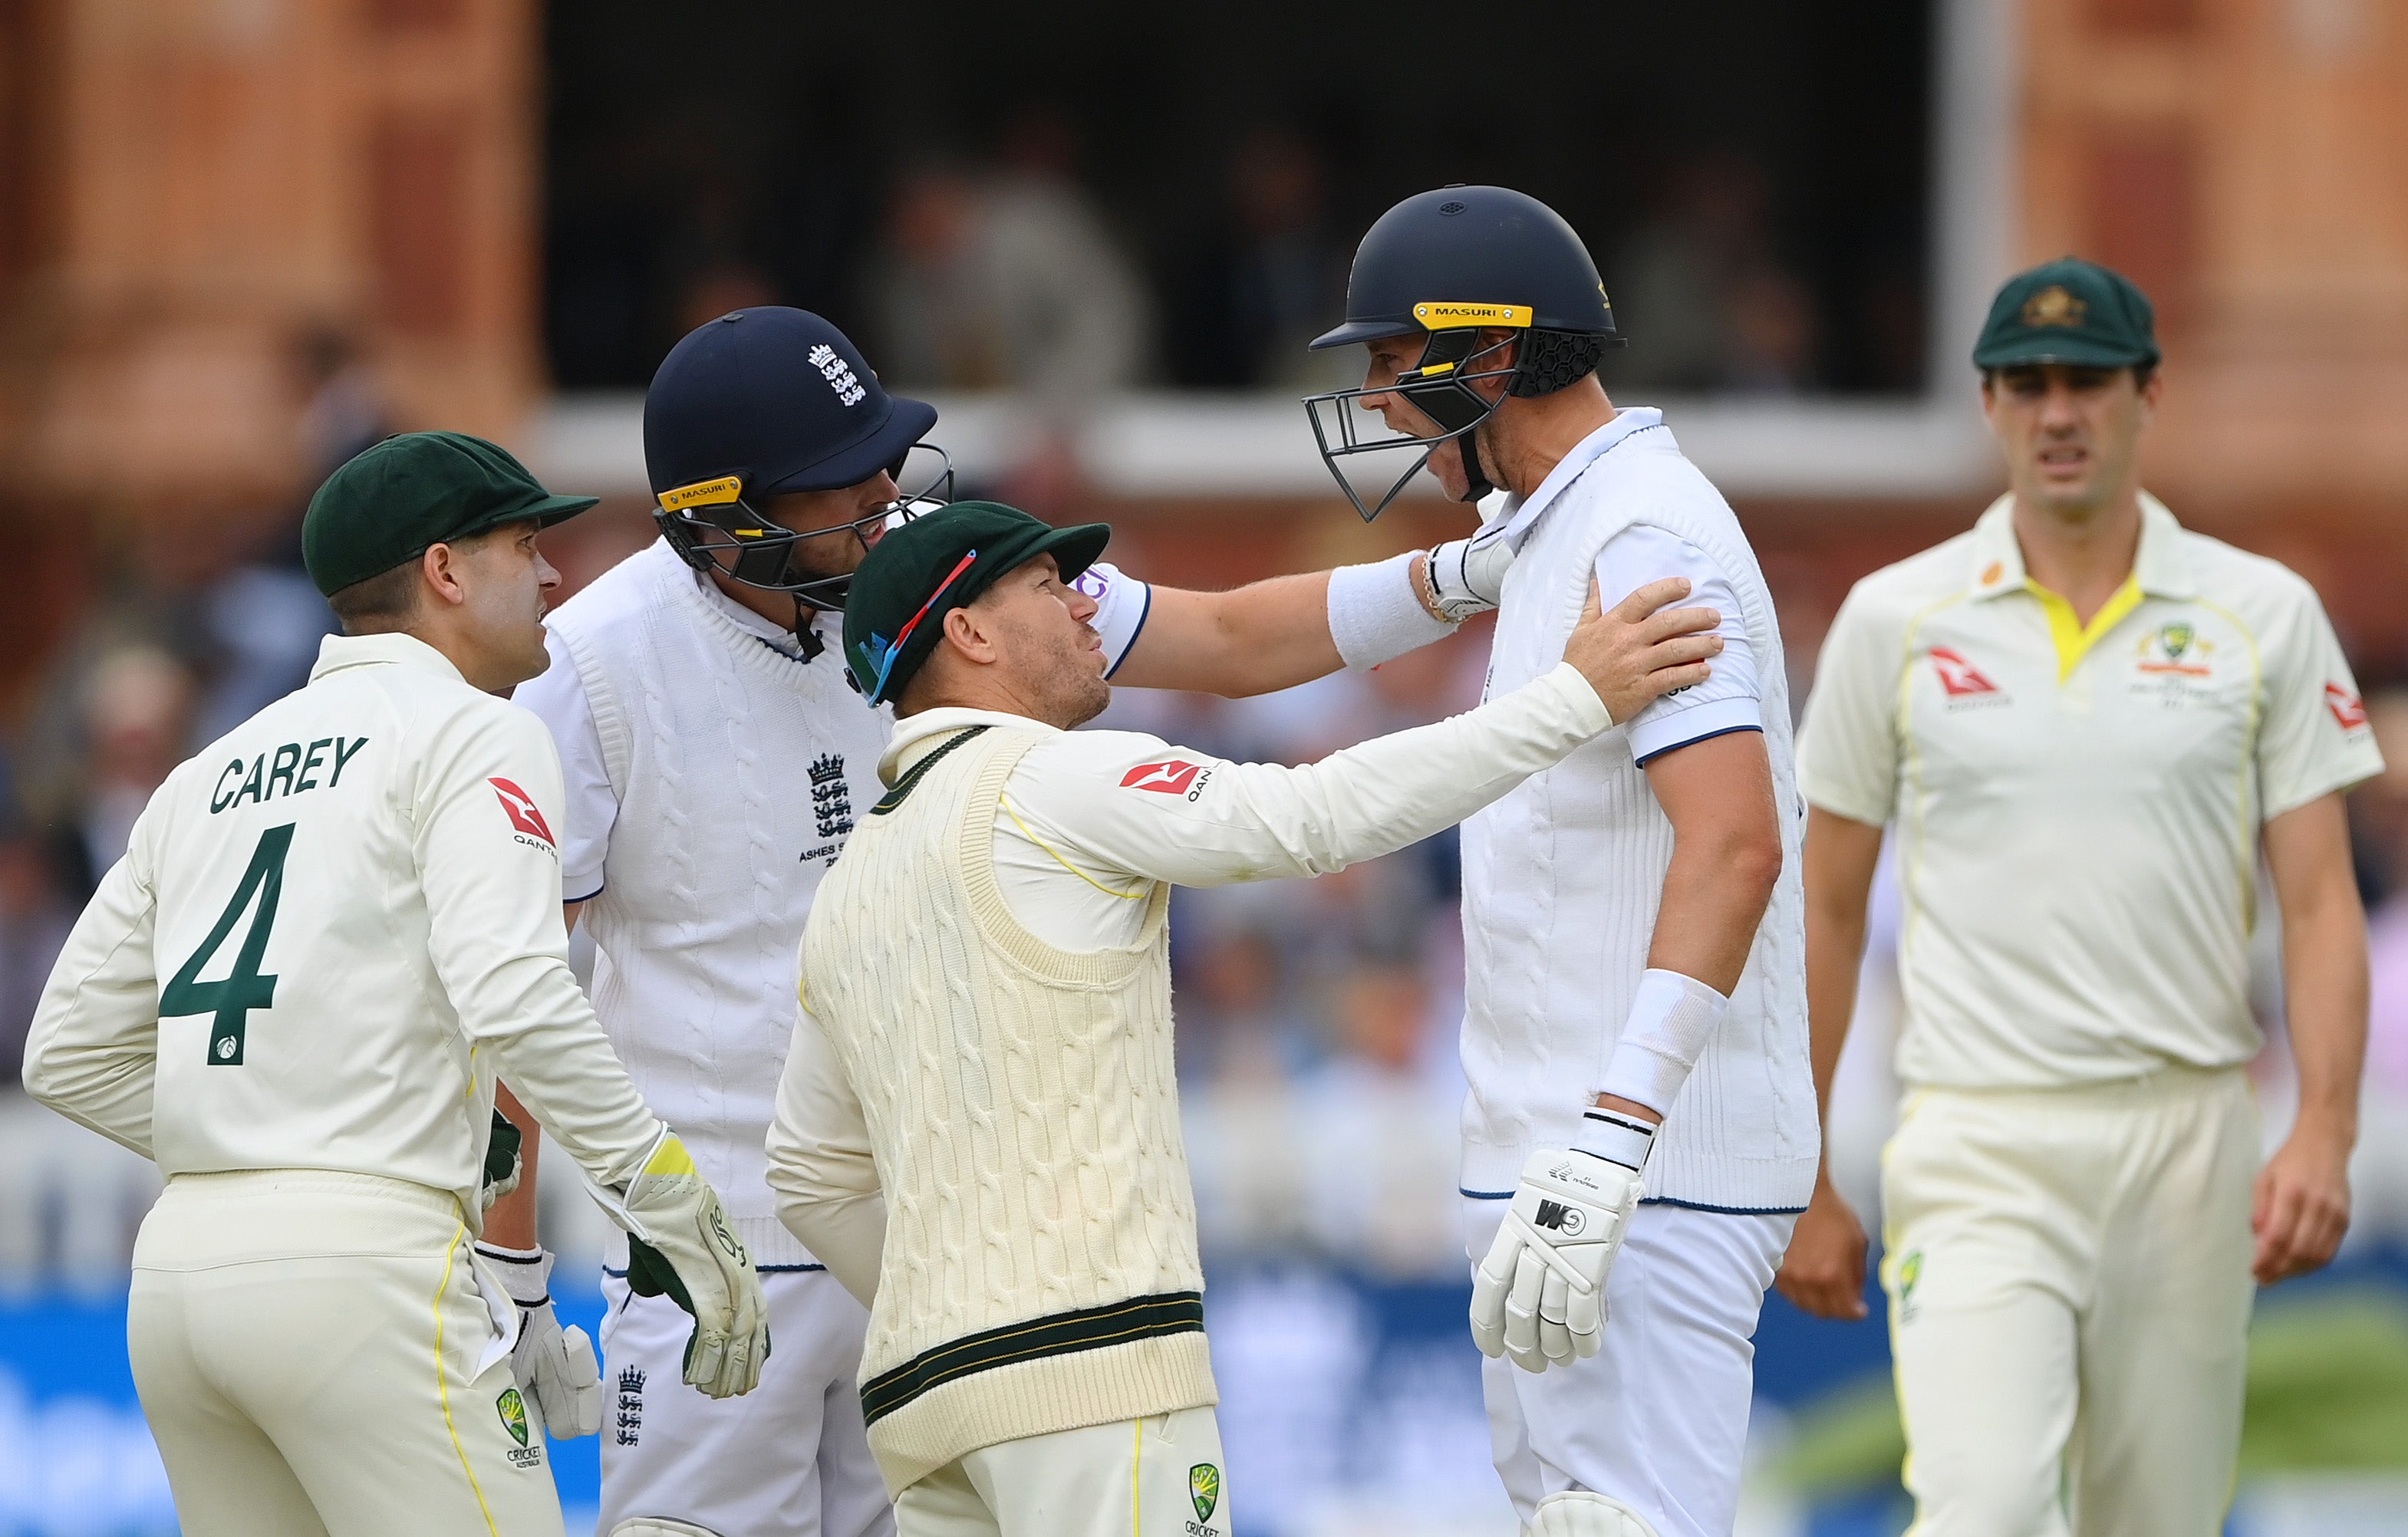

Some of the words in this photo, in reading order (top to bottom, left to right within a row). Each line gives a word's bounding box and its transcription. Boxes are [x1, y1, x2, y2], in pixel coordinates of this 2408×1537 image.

[1435, 308, 1496, 317] MASURI
[681, 483, 726, 499] MASURI
[209, 736, 370, 815] CAREY
[1188, 769, 1212, 802] QAN
[799, 844, 835, 863] ASHES
[158, 821, 298, 1066] 4
[507, 1446, 541, 1462] CRICKET
[1185, 1520, 1219, 1537] CRICKET
